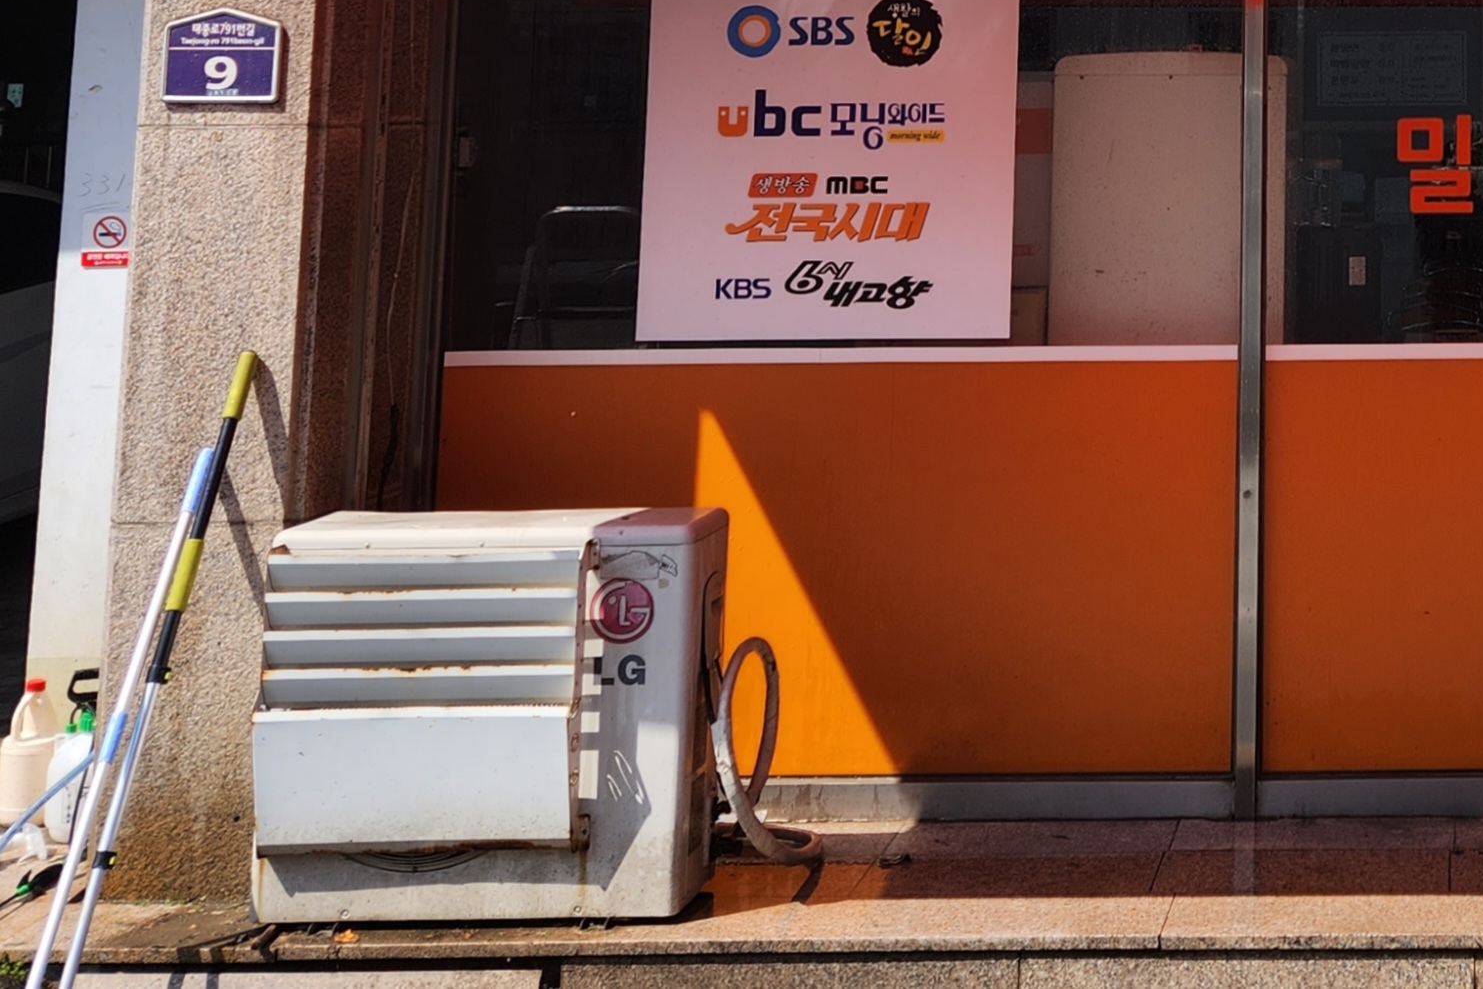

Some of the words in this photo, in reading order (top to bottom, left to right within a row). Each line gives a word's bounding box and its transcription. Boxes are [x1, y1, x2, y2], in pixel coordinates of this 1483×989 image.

[787, 16, 856, 47] SBS
[872, 17, 932, 56] 달인
[204, 56, 238, 90] 9
[717, 89, 822, 137] ubc
[889, 131, 922, 142] morning
[923, 130, 942, 141] wide
[755, 176, 811, 195] 생방송
[724, 202, 931, 243] 전국시대
[715, 277, 772, 300] KBS
[593, 654, 646, 686] LG
